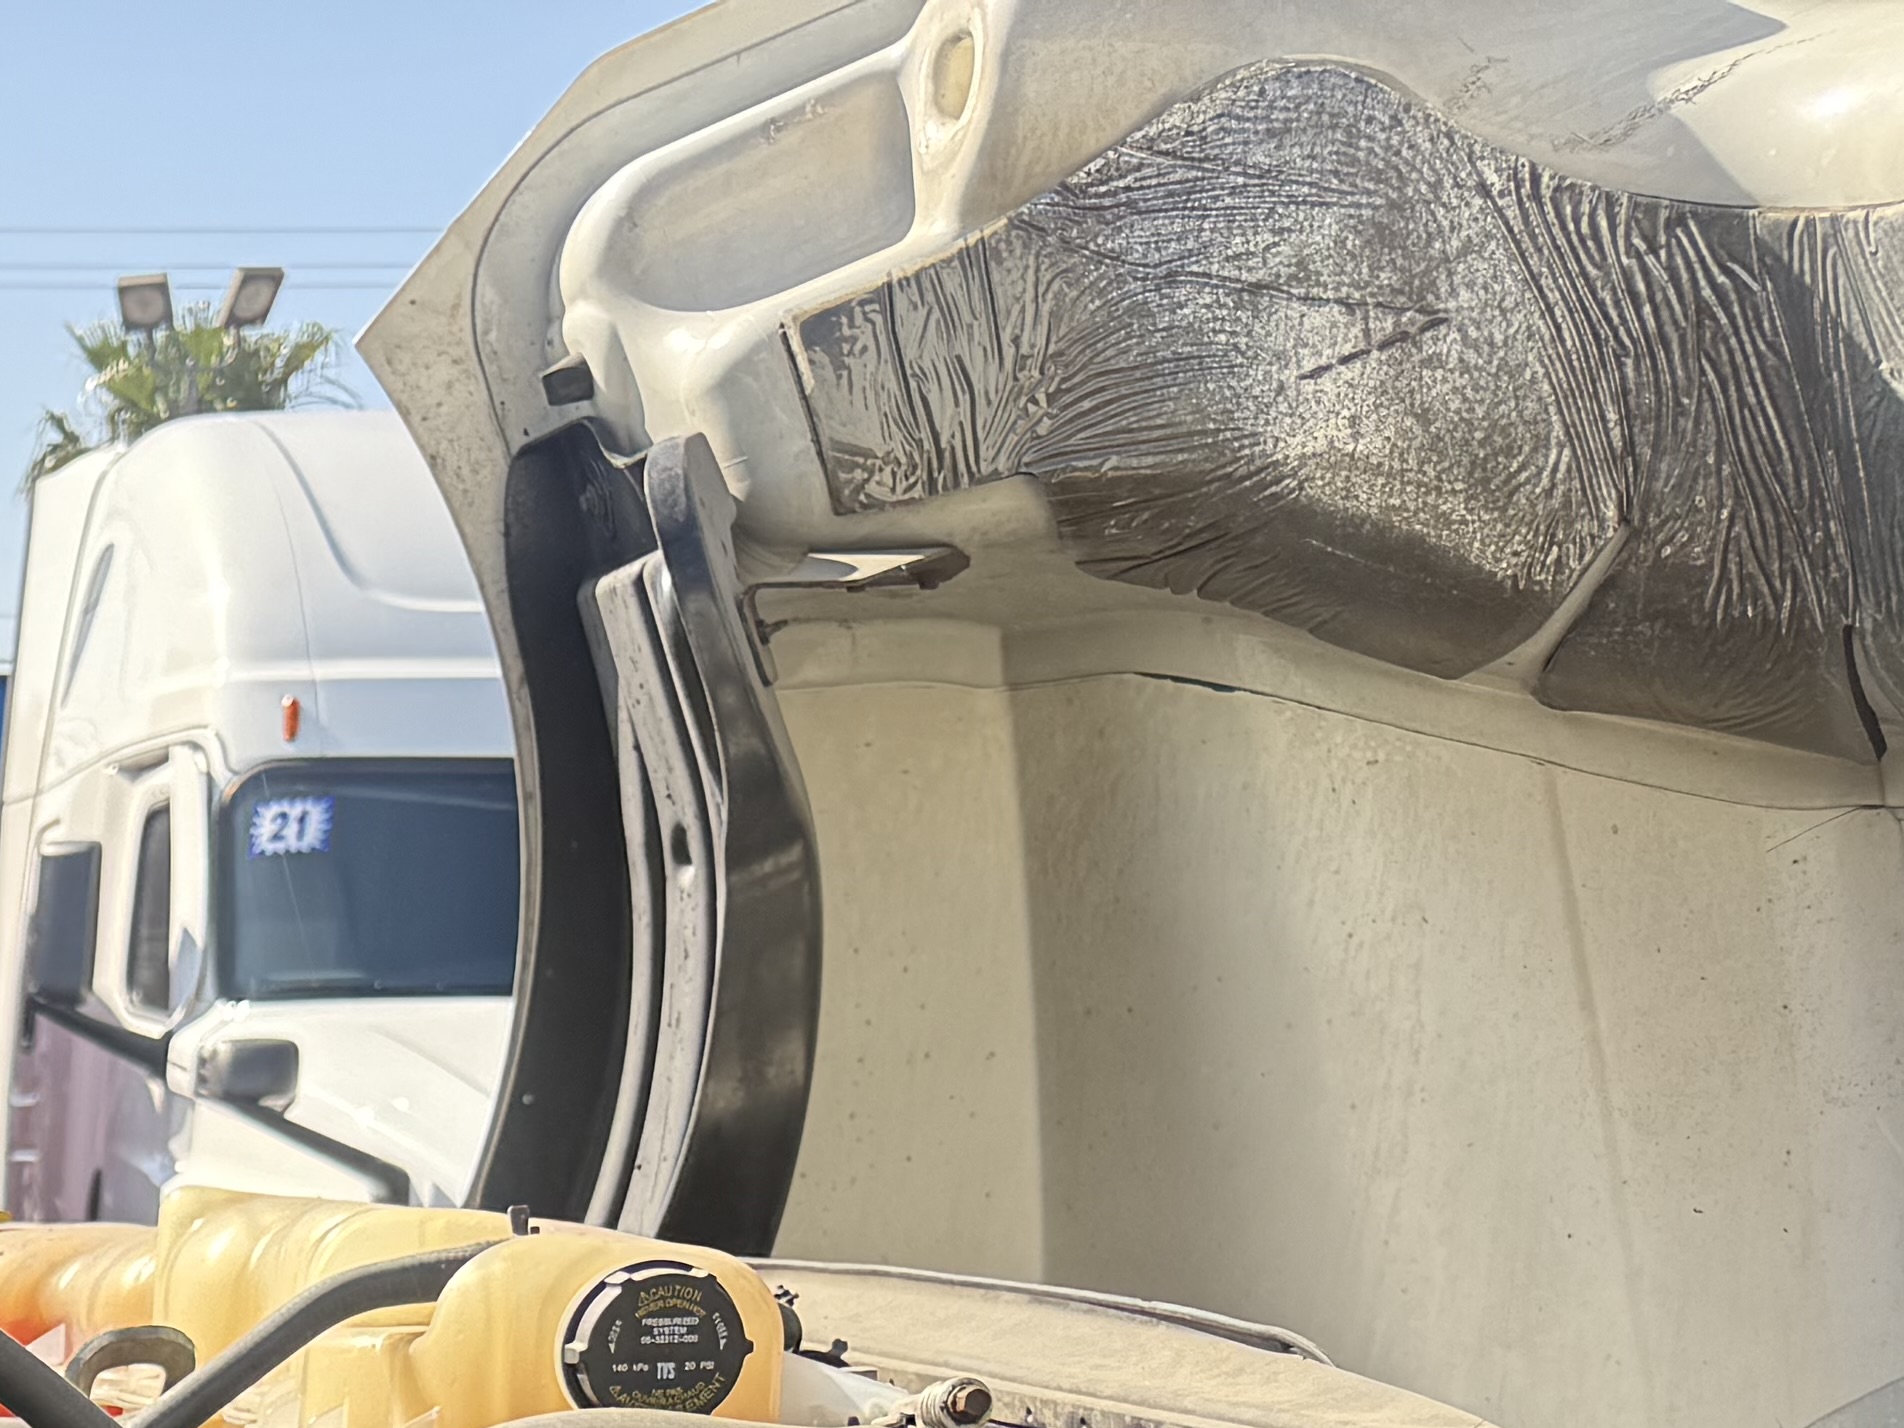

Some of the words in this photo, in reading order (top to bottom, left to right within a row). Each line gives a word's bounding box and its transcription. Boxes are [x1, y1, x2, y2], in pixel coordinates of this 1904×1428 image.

[650, 1285, 703, 1302] CAUTION
[652, 1325, 688, 1336] SYSTEM
[684, 1361, 696, 1371] 20
[699, 1361, 715, 1370] PSI
